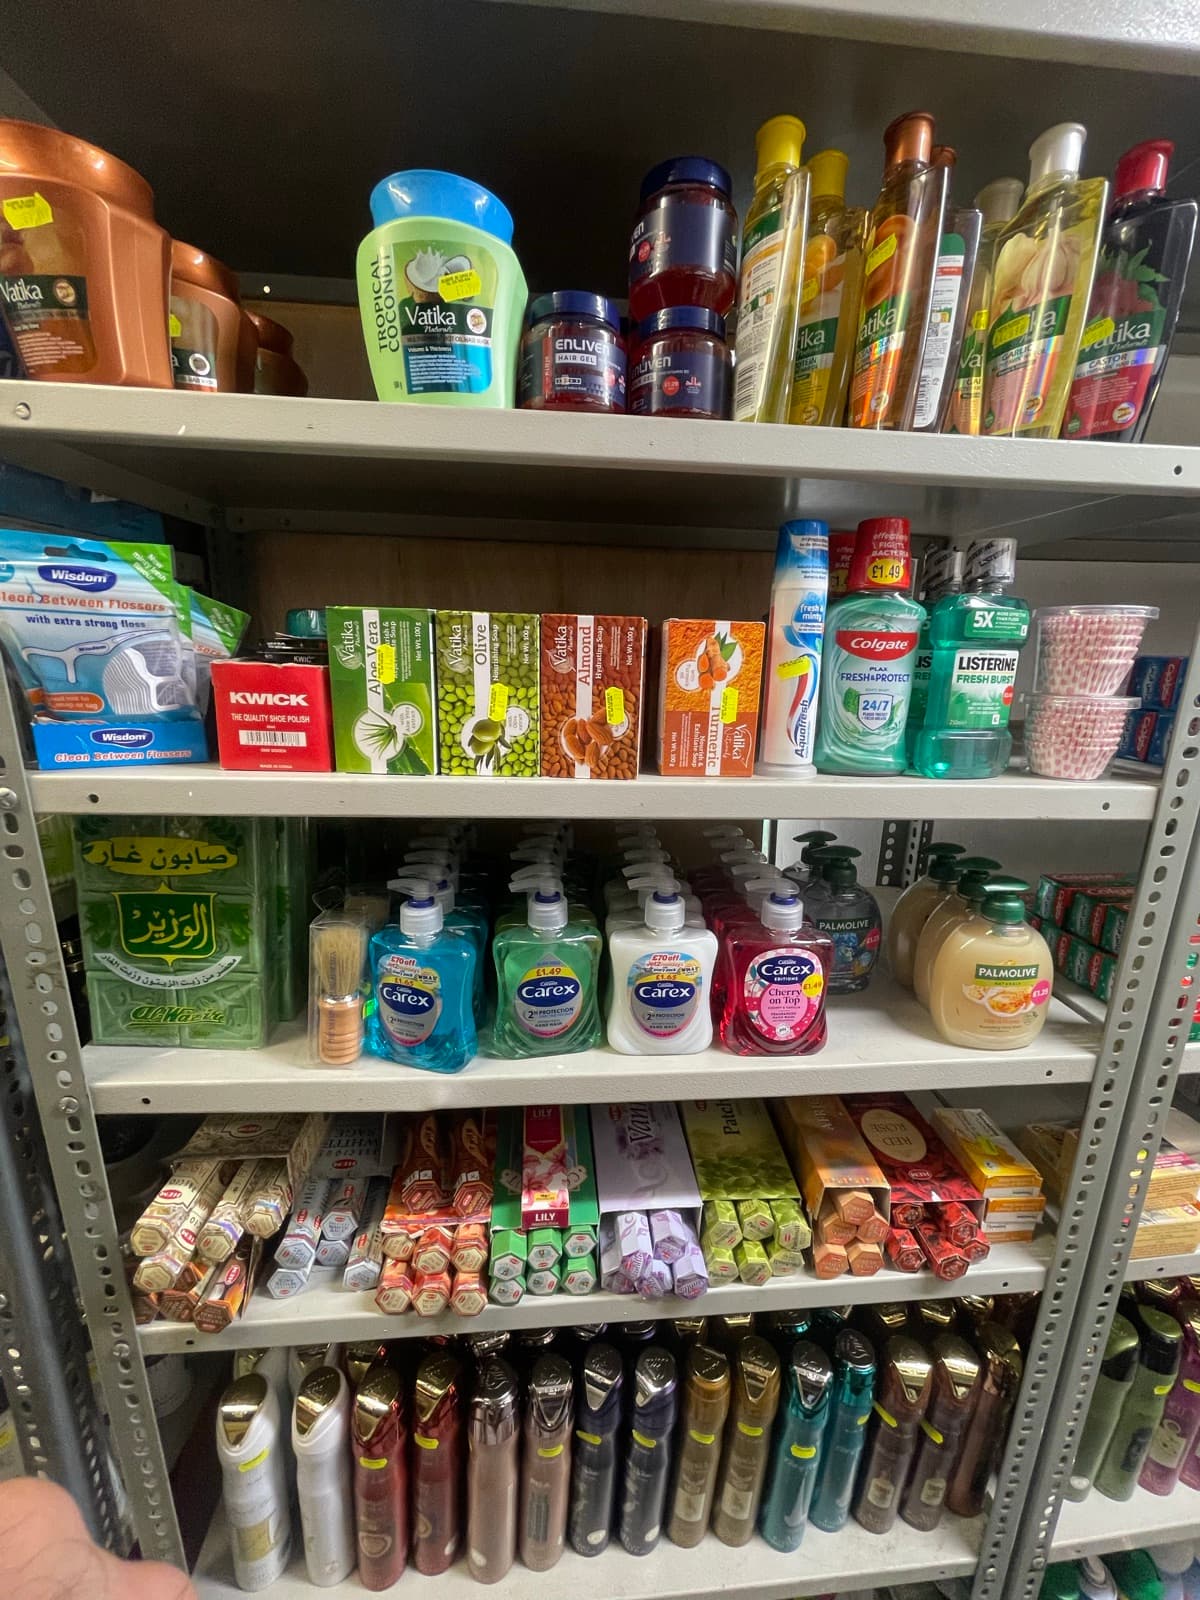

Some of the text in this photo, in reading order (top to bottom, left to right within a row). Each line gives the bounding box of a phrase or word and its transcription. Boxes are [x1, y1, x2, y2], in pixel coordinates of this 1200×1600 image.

[0, 279, 43, 302] Vatika
[370, 254, 388, 352] TROPICAL
[383, 254, 400, 353] COCONUT
[405, 305, 456, 326] Vatika
[859, 308, 897, 341] atika
[1089, 353, 1127, 368] CASTOR
[51, 569, 107, 584] Wisdom
[872, 565, 900, 578] £1.49
[1, 592, 165, 611] lean Between Flossers
[26, 615, 146, 629] with extra strong floss
[973, 611, 994, 627] 5X
[341, 621, 355, 661] Vatika
[448, 624, 462, 665] Vatika
[474, 624, 488, 666] Olive
[554, 625, 567, 666] Vatika
[850, 637, 908, 652] Colgate
[294, 655, 312, 664] KWIC
[366, 621, 381, 696] Aloe Vera
[578, 626, 591, 686] Almond
[595, 625, 604, 680] Hydrating Soap
[958, 656, 1016, 671] LISTERINE
[956, 674, 1013, 684] FRESH BURST
[229, 691, 309, 706] KWICK
[862, 700, 889, 711] 24/7
[231, 713, 310, 723] THE QUALITY SHOE POLISH
[794, 699, 809, 758] Aquafresh
[102, 733, 146, 742] Wisdom
[732, 724, 746, 759] Vatika
[691, 724, 701, 768] Exfoliate Soap
[55, 749, 191, 762] Clean Between Flossers
[98, 844, 227, 870] صابون غار
[820, 920, 869, 930] PALMOLIVE
[536, 968, 561, 976] £1.49
[761, 965, 811, 975] Carex
[979, 967, 1036, 978] PALMOLIVE
[142, 978, 178, 987] الزيتون
[383, 987, 430, 1007] Carex
[521, 985, 575, 998] Carex
[639, 986, 690, 997] Carex
[783, 997, 800, 1005] Top
[871, 1123, 907, 1133] ROSE
[882, 1136, 912, 1146] RED
[159, 1190, 182, 1199] HEM
[535, 1212, 555, 1221] LILY
